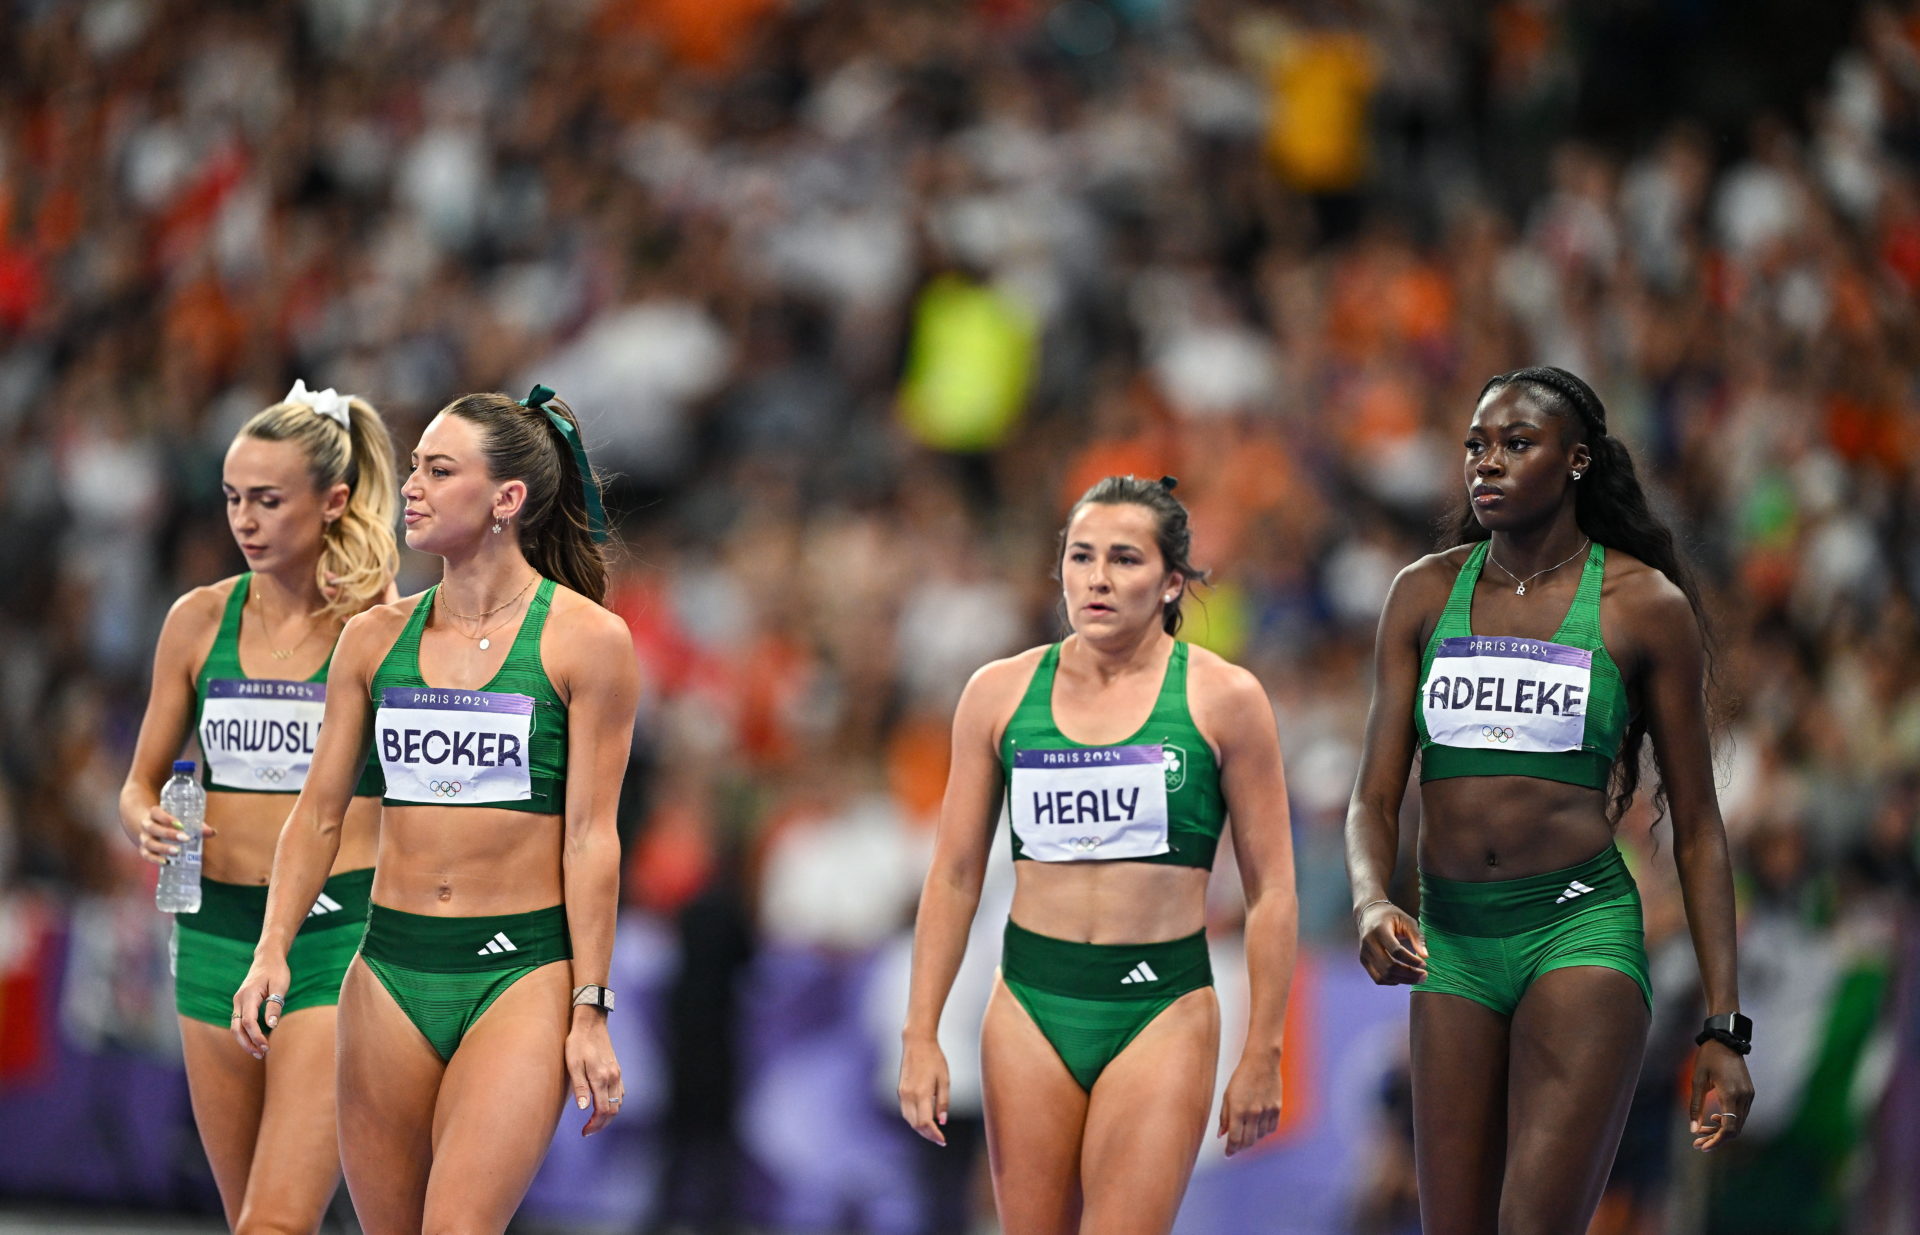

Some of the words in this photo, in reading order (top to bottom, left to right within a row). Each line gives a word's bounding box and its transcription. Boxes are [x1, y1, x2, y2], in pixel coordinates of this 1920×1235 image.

[1469, 641, 1506, 652] PARIS
[1511, 642, 1548, 656] 2024
[238, 682, 274, 695] PARIS
[277, 684, 313, 697] 2024
[454, 695, 489, 707] 2024
[1428, 675, 1584, 717] ADELEKE
[205, 718, 322, 754] MAWDSL
[382, 728, 522, 767] BECKER
[1043, 751, 1080, 764] PARIS
[1084, 750, 1120, 763] 2024
[1033, 786, 1140, 825] HEALY
